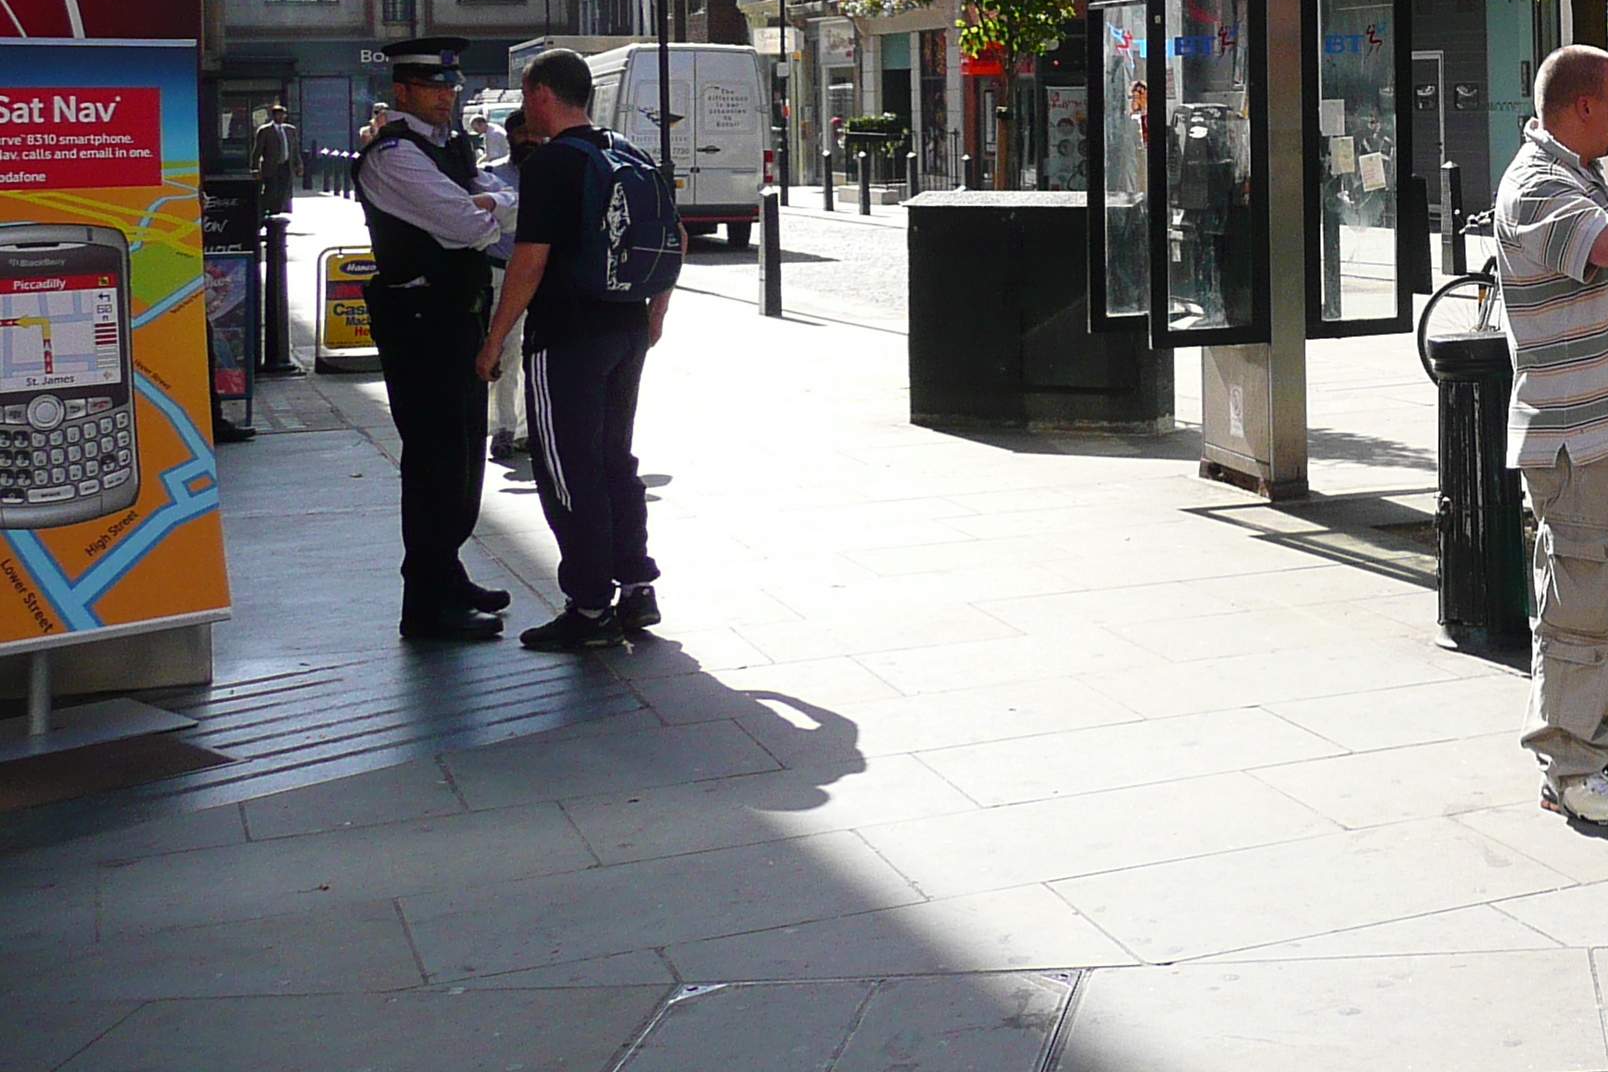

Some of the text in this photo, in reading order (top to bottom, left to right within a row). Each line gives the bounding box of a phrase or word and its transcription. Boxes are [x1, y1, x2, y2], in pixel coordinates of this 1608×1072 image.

[1323, 34, 1365, 55] BT
[360, 49, 389, 63] Bo
[0, 95, 45, 123] Sat
[27, 134, 57, 145] 8310
[58, 134, 134, 146] smartphone.
[22, 149, 52, 160] calls
[54, 148, 77, 159] and
[79, 147, 113, 159] email
[115, 147, 127, 158] in
[129, 148, 153, 158] one.
[13, 279, 67, 290] Piccadilly
[26, 375, 75, 387] St. James
[134, 358, 172, 390] Upper Street
[84, 510, 140, 557] High Street
[0, 558, 54, 633] Lower Street
